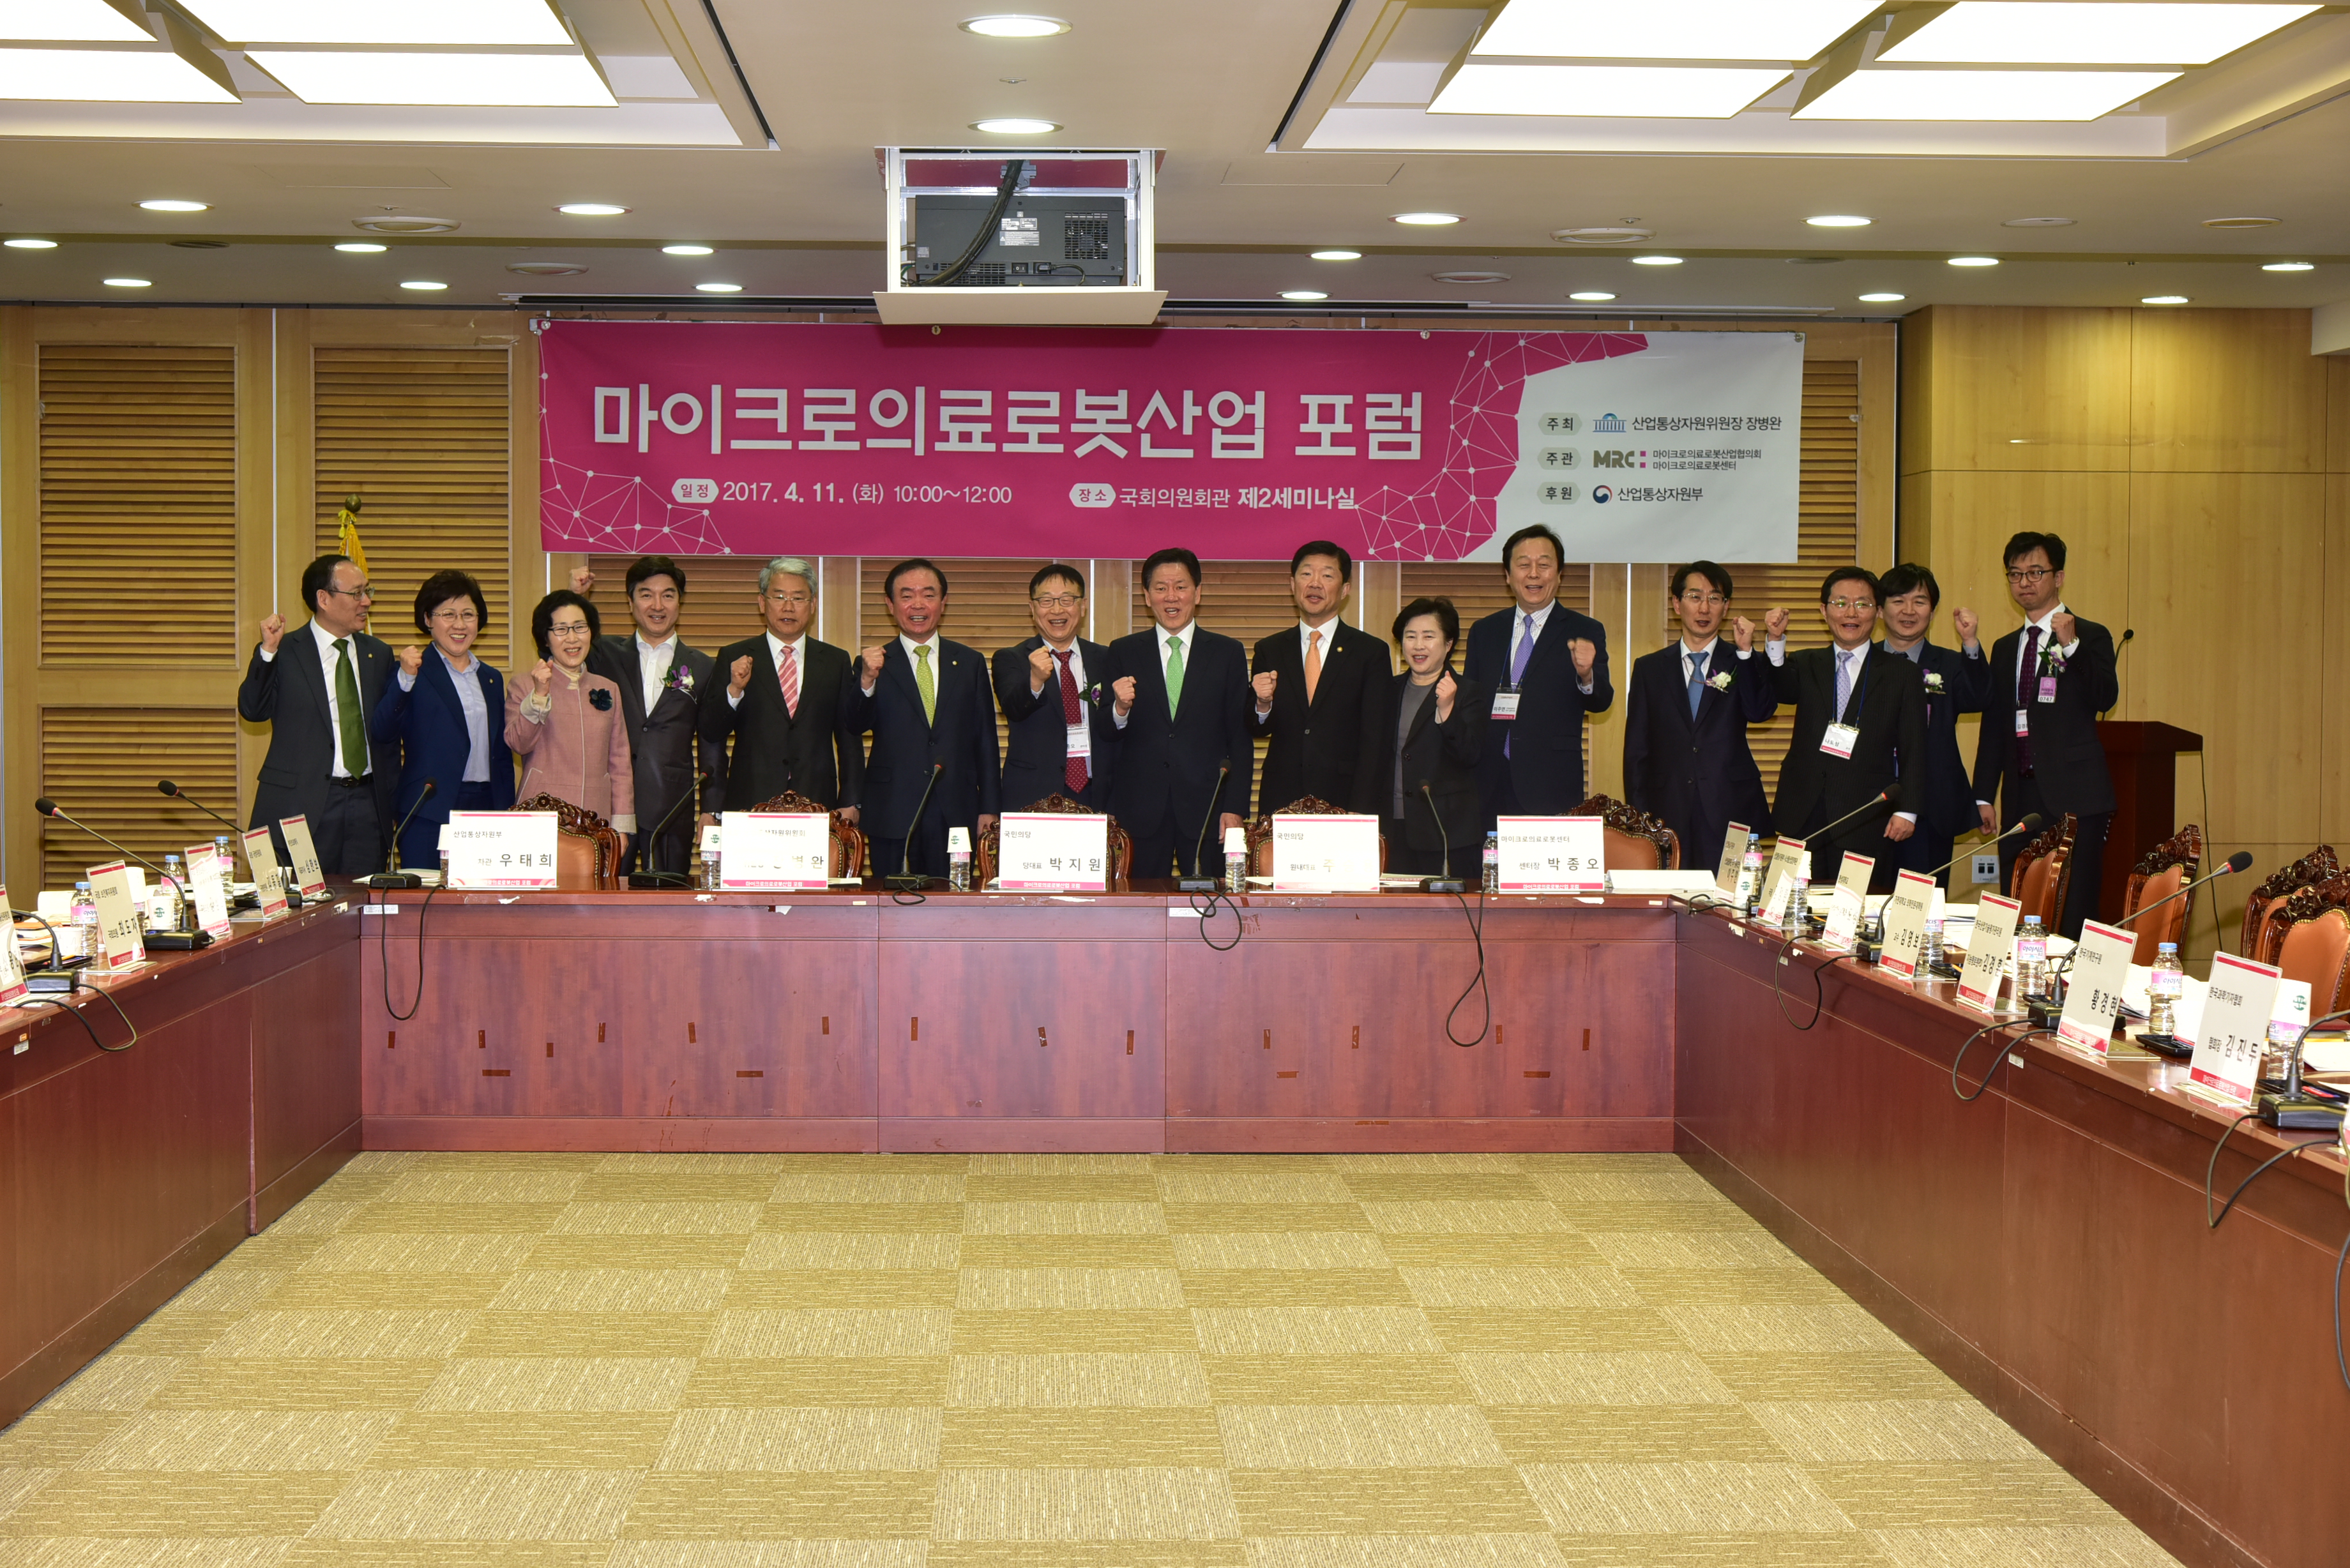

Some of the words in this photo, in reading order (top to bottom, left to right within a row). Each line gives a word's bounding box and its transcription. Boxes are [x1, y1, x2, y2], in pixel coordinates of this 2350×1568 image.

[594, 384, 1265, 458] 마이크로의료로봇산업
[1294, 391, 1422, 460] 포럼
[1547, 417, 1573, 431] 주최
[1632, 416, 1743, 431] 산업통상자원위원장
[1746, 416, 1782, 431] 장병완
[1546, 452, 1573, 465] 주관
[1593, 450, 1635, 468] MRC
[1653, 449, 1761, 459] 마이크로의료로봇산업협의회
[1653, 460, 1736, 471] 마이크로의료로봇센터
[681, 484, 709, 498] 일정
[723, 481, 778, 502] 2017.
[784, 482, 804, 502] 4.
[813, 482, 844, 503] 11.
[853, 483, 884, 504] (화)
[1078, 488, 1108, 502] 장소
[1119, 488, 1231, 508] 국회의원회관
[1238, 486, 1354, 509] 제2세미나실
[1545, 486, 1572, 500] 후원
[1618, 487, 1703, 501] 산업통상자원부
[2209, 987, 2243, 1006] 한국과학기자협회
